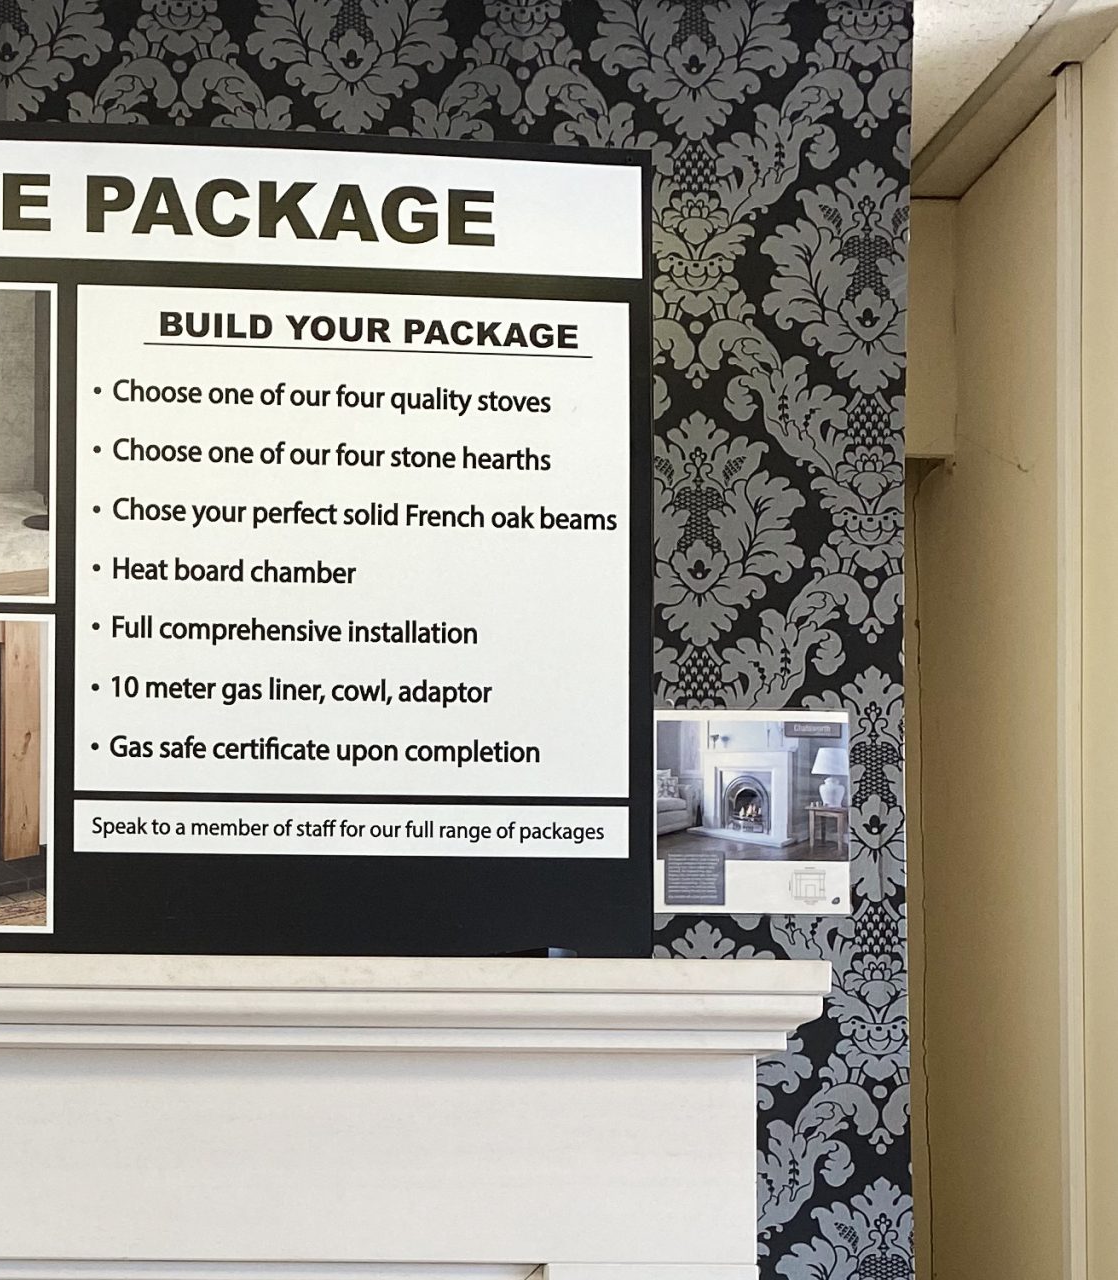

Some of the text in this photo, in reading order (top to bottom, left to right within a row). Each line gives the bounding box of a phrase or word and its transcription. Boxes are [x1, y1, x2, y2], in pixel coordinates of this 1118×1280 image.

[85, 174, 496, 247] PACKAGE
[159, 311, 580, 350] BUILD YOUR PACKAGE
[112, 379, 552, 417] Choose one of our four quality stoves
[112, 438, 551, 472] Choose one of our four stone hearths
[112, 497, 618, 532] Chose your perfect solid French oak beams
[113, 557, 356, 585] Heat board chamber
[112, 615, 478, 647] Full comprehensive installation
[111, 676, 492, 708] 10 meter gas liner, cowl, adaptor
[110, 735, 540, 767] Gas safe certificate upon completion
[92, 816, 604, 846] Speak to a member of staff for our full range of packages
